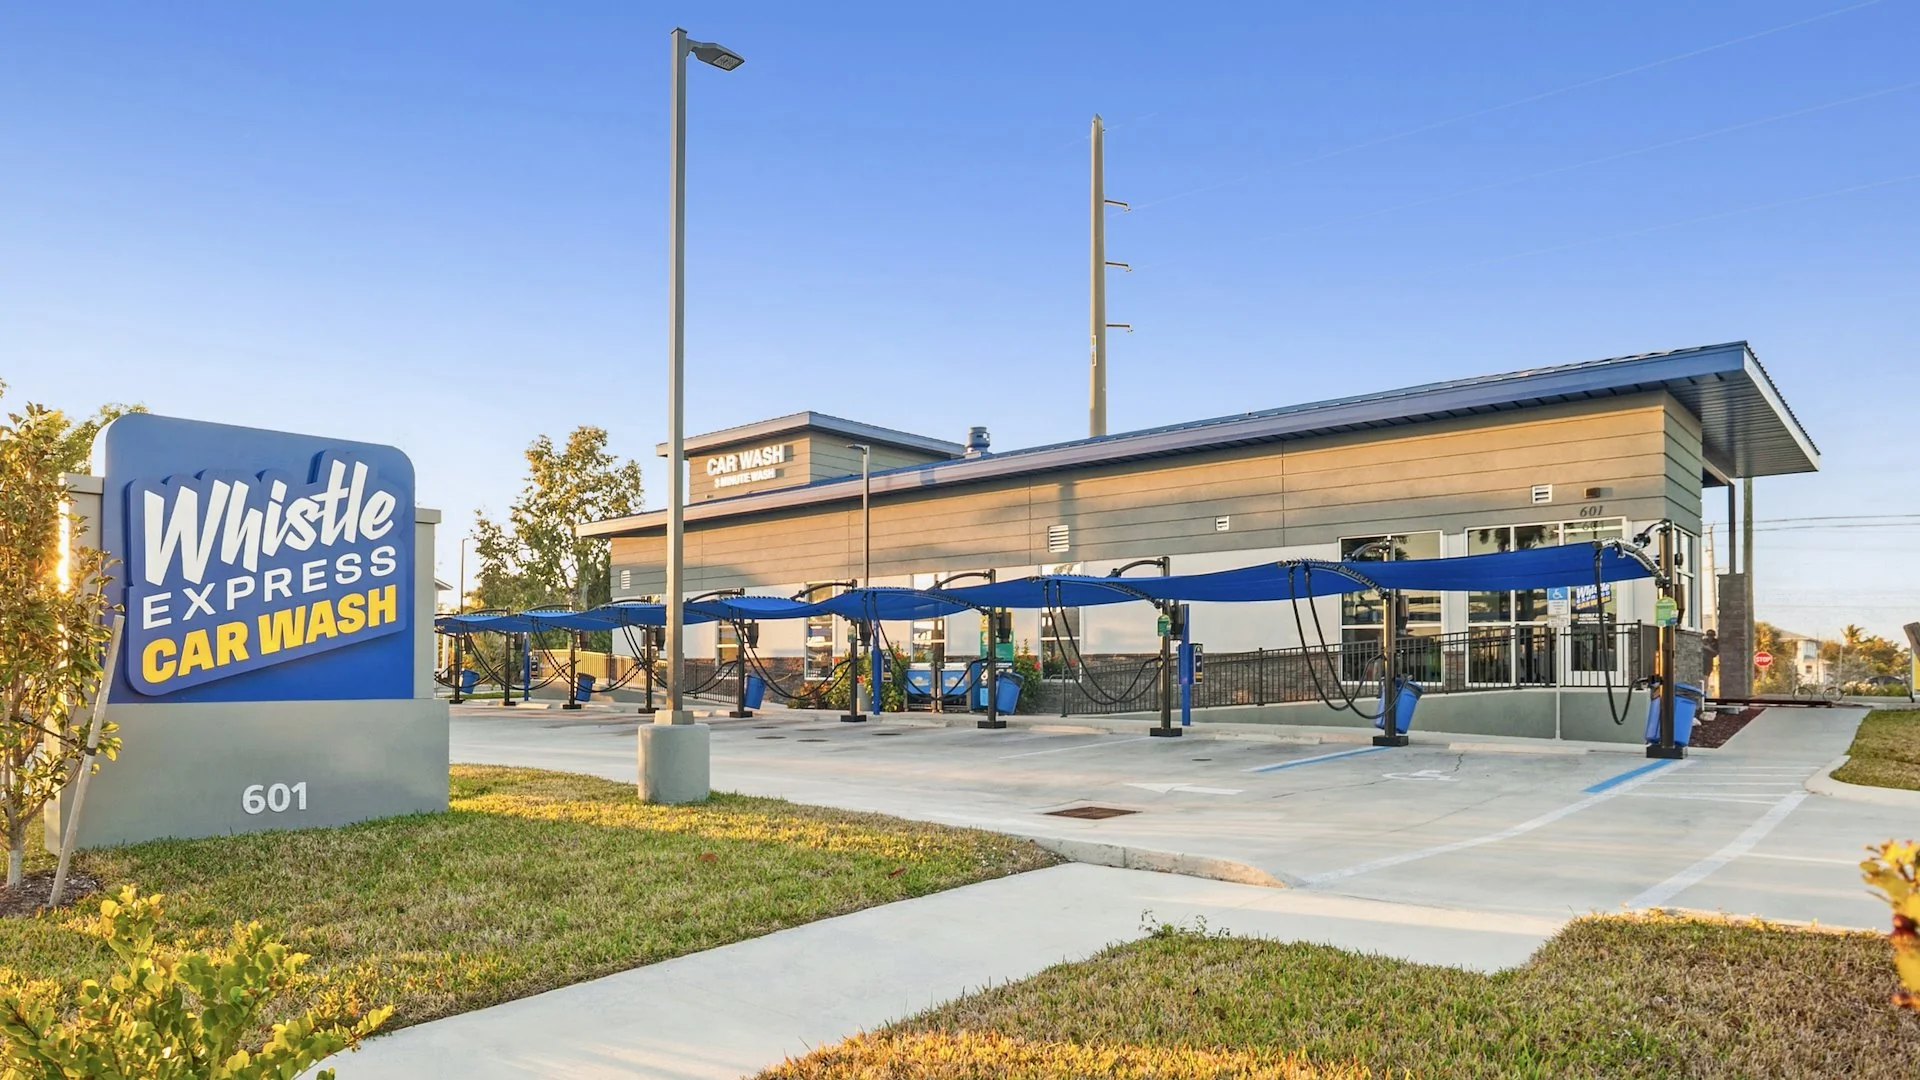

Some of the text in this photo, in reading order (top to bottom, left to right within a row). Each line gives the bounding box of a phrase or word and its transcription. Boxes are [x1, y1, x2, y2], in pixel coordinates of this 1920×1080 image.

[706, 444, 785, 476] CAR WASH
[720, 472, 751, 488] MINUTE
[751, 468, 777, 482] WASH
[144, 459, 396, 587] Whistle
[1580, 505, 1603, 517] 601
[143, 545, 397, 630] EXPRESS
[142, 584, 397, 684] CAR WASH
[242, 781, 307, 815] 601
